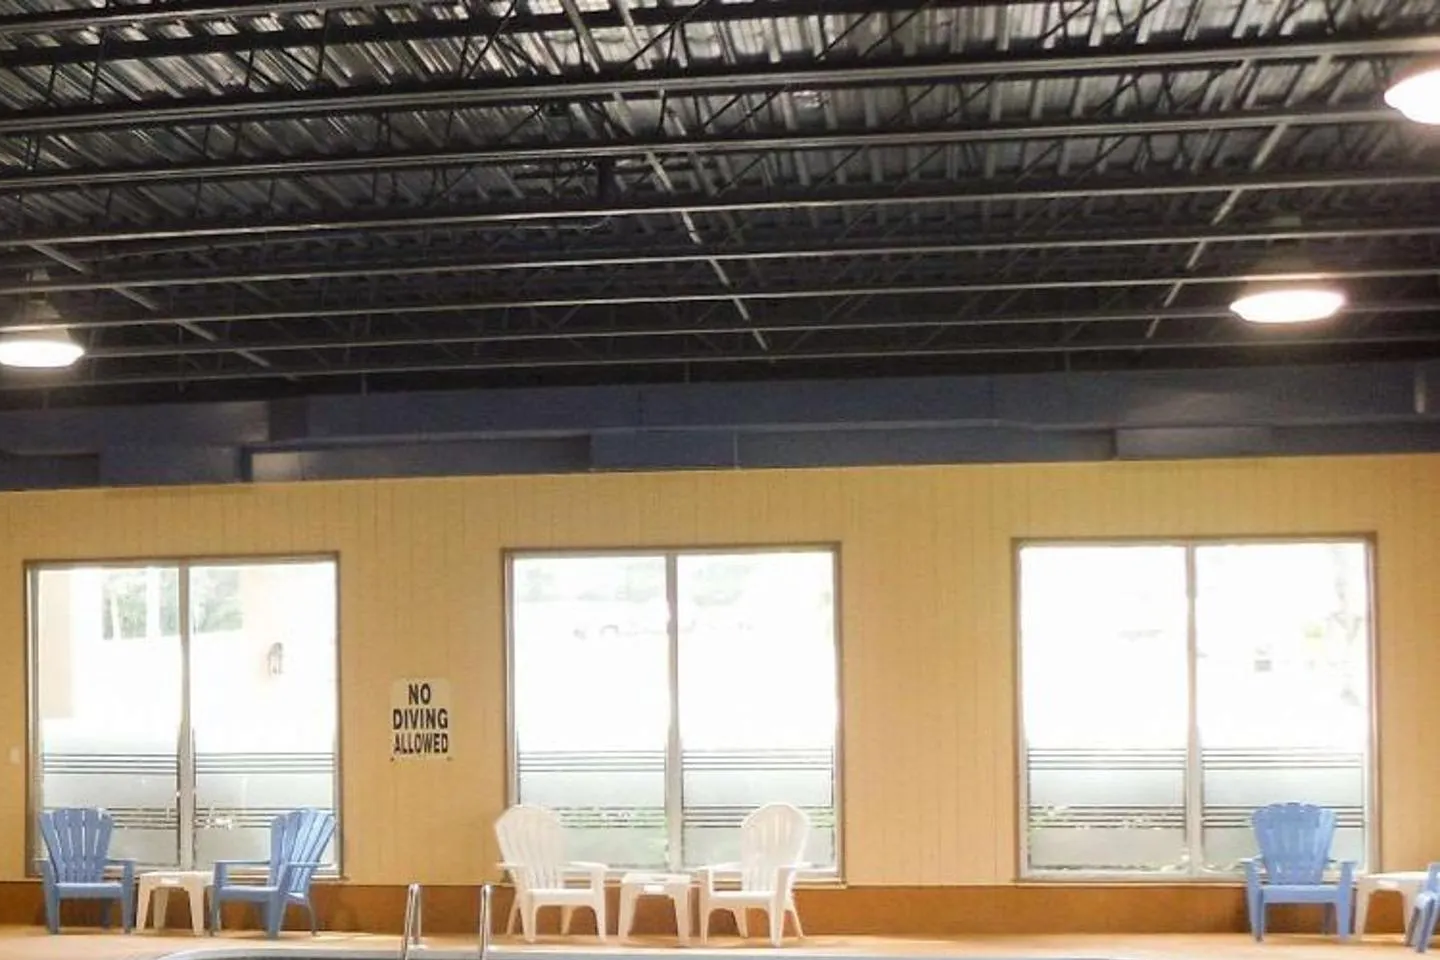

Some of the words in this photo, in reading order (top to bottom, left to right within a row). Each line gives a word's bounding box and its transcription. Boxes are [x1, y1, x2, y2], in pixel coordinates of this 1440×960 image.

[408, 683, 431, 705] NO
[393, 708, 448, 730] DIVING
[393, 733, 448, 754] ALLOWED
